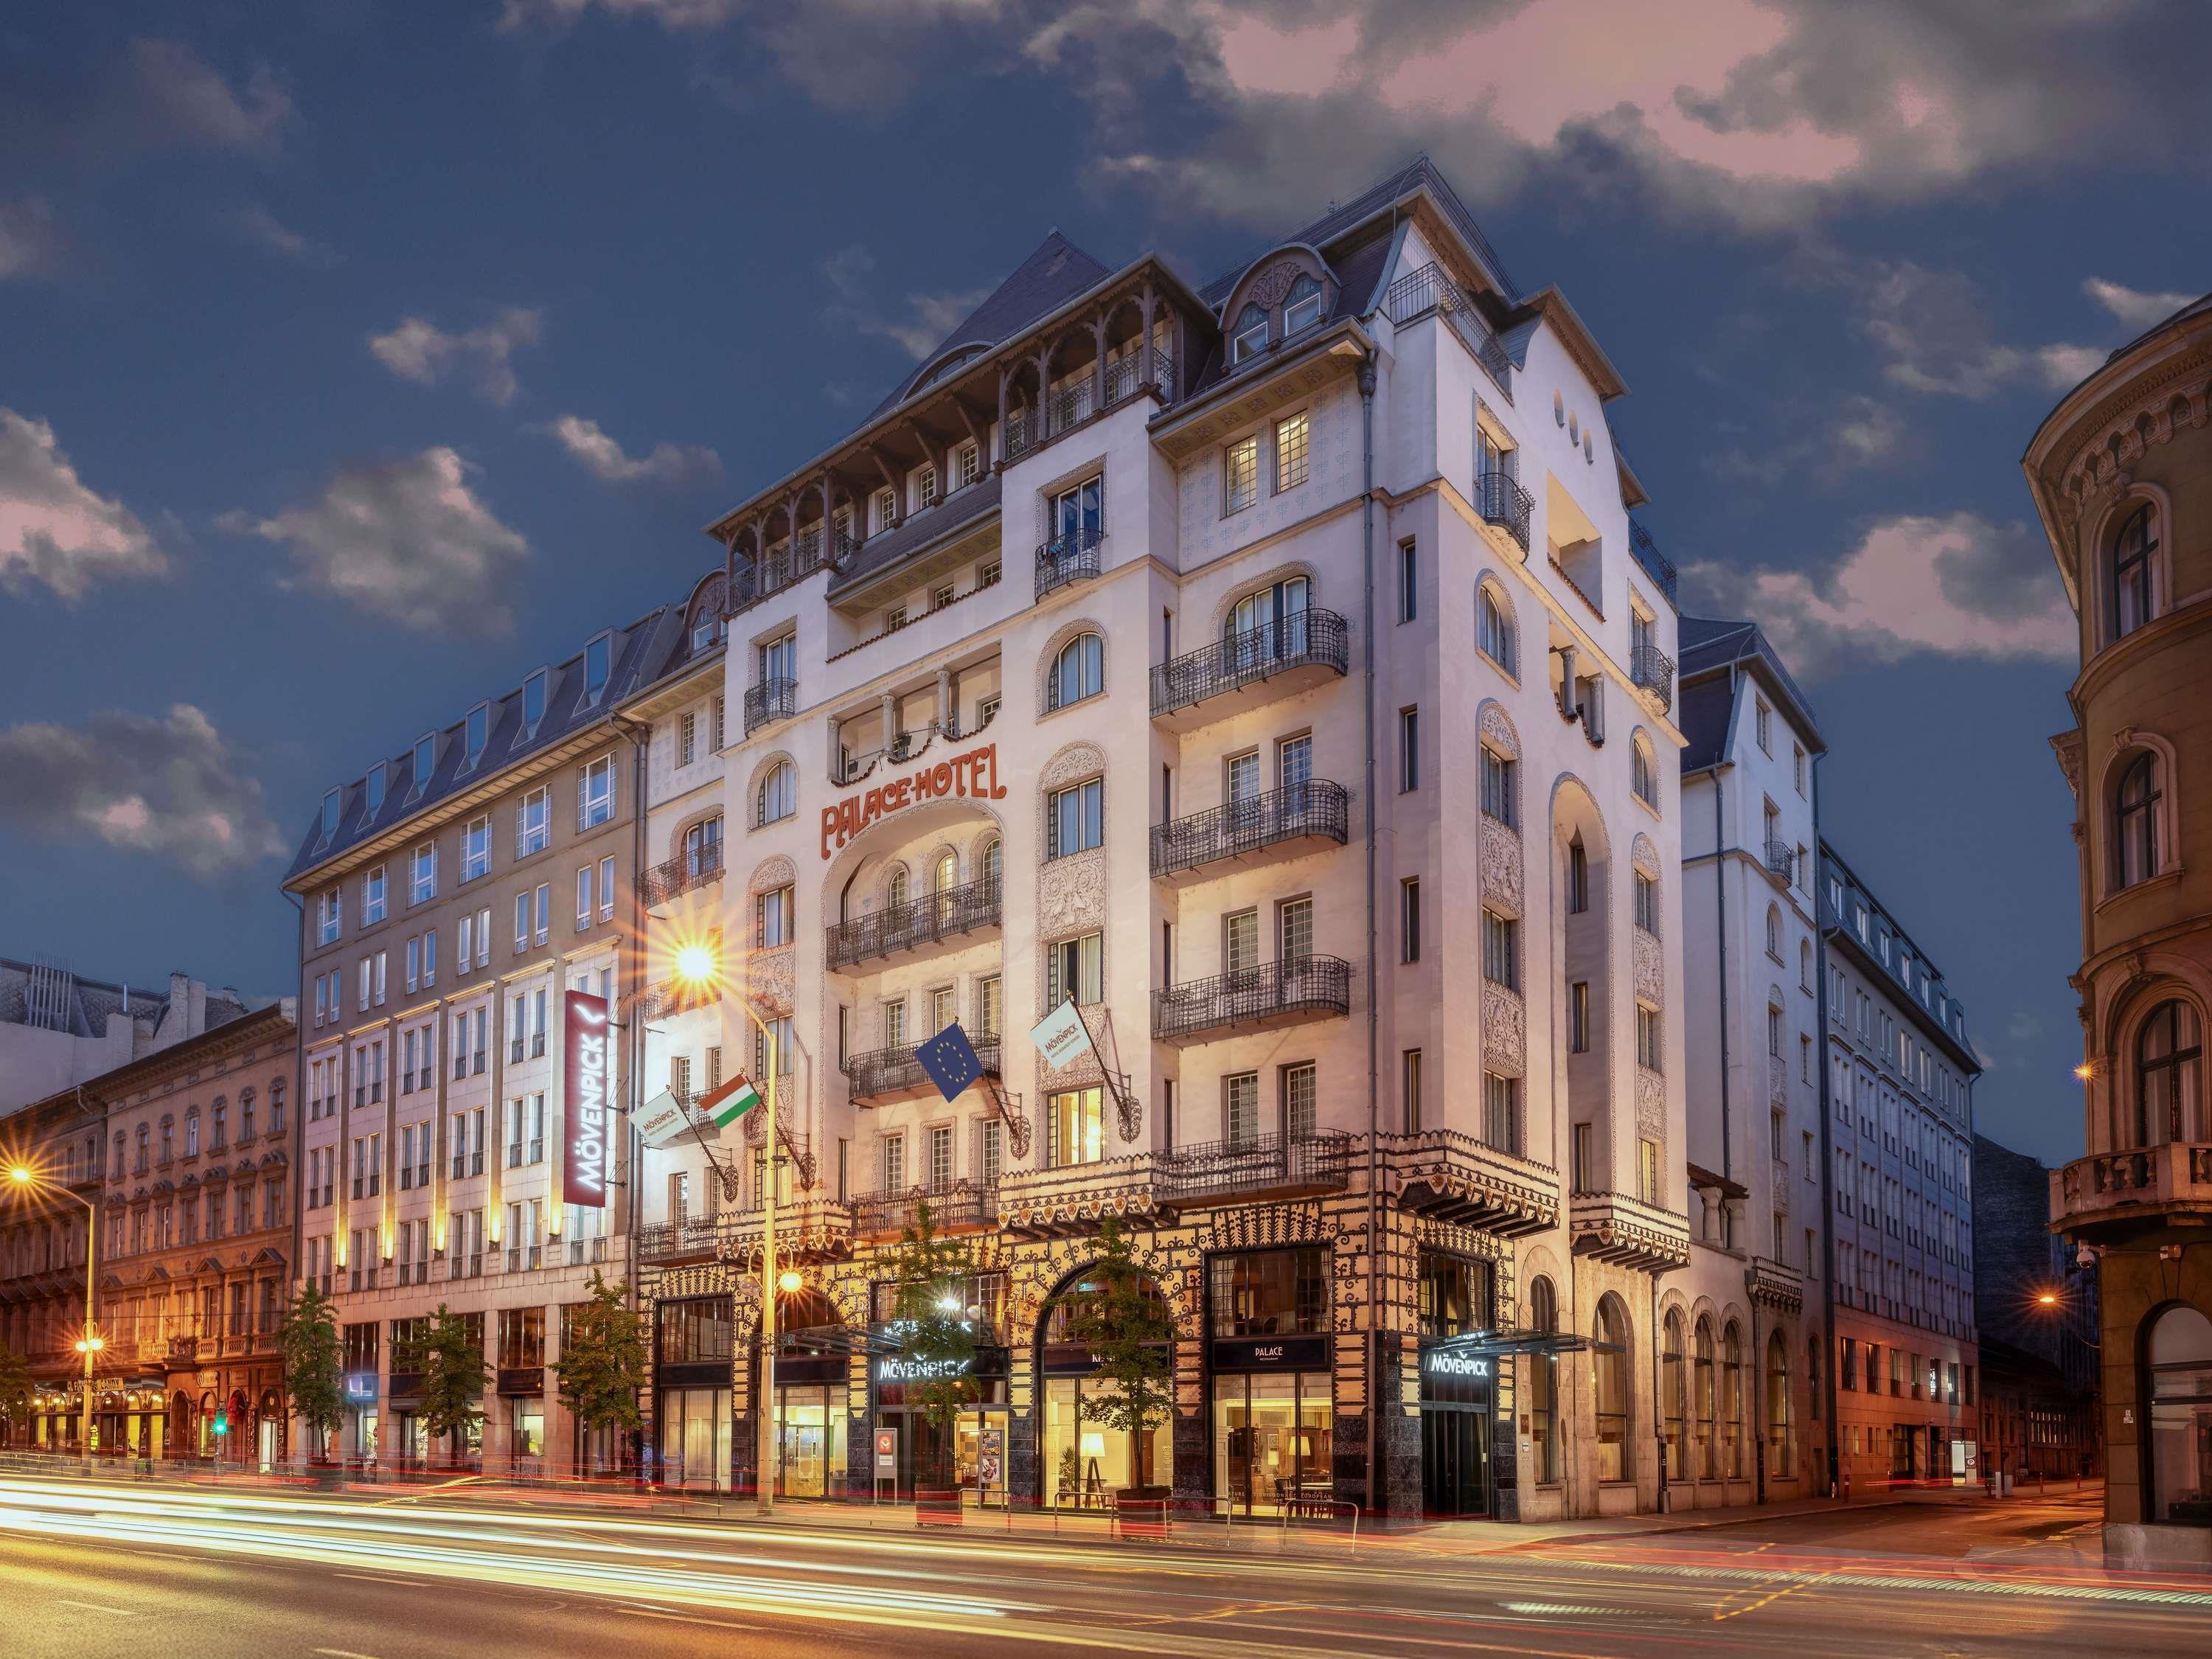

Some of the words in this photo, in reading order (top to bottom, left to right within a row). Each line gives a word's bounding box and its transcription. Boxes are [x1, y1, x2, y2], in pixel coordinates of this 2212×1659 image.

[1045, 1023, 1079, 1053] MÖVENPICK
[574, 1032, 604, 1192] MÖVENPICK
[643, 1108, 676, 1132] MÖVENPICK
[1255, 1346, 1283, 1357] PALACE
[1431, 1353, 1488, 1377] MÖVENPICK
